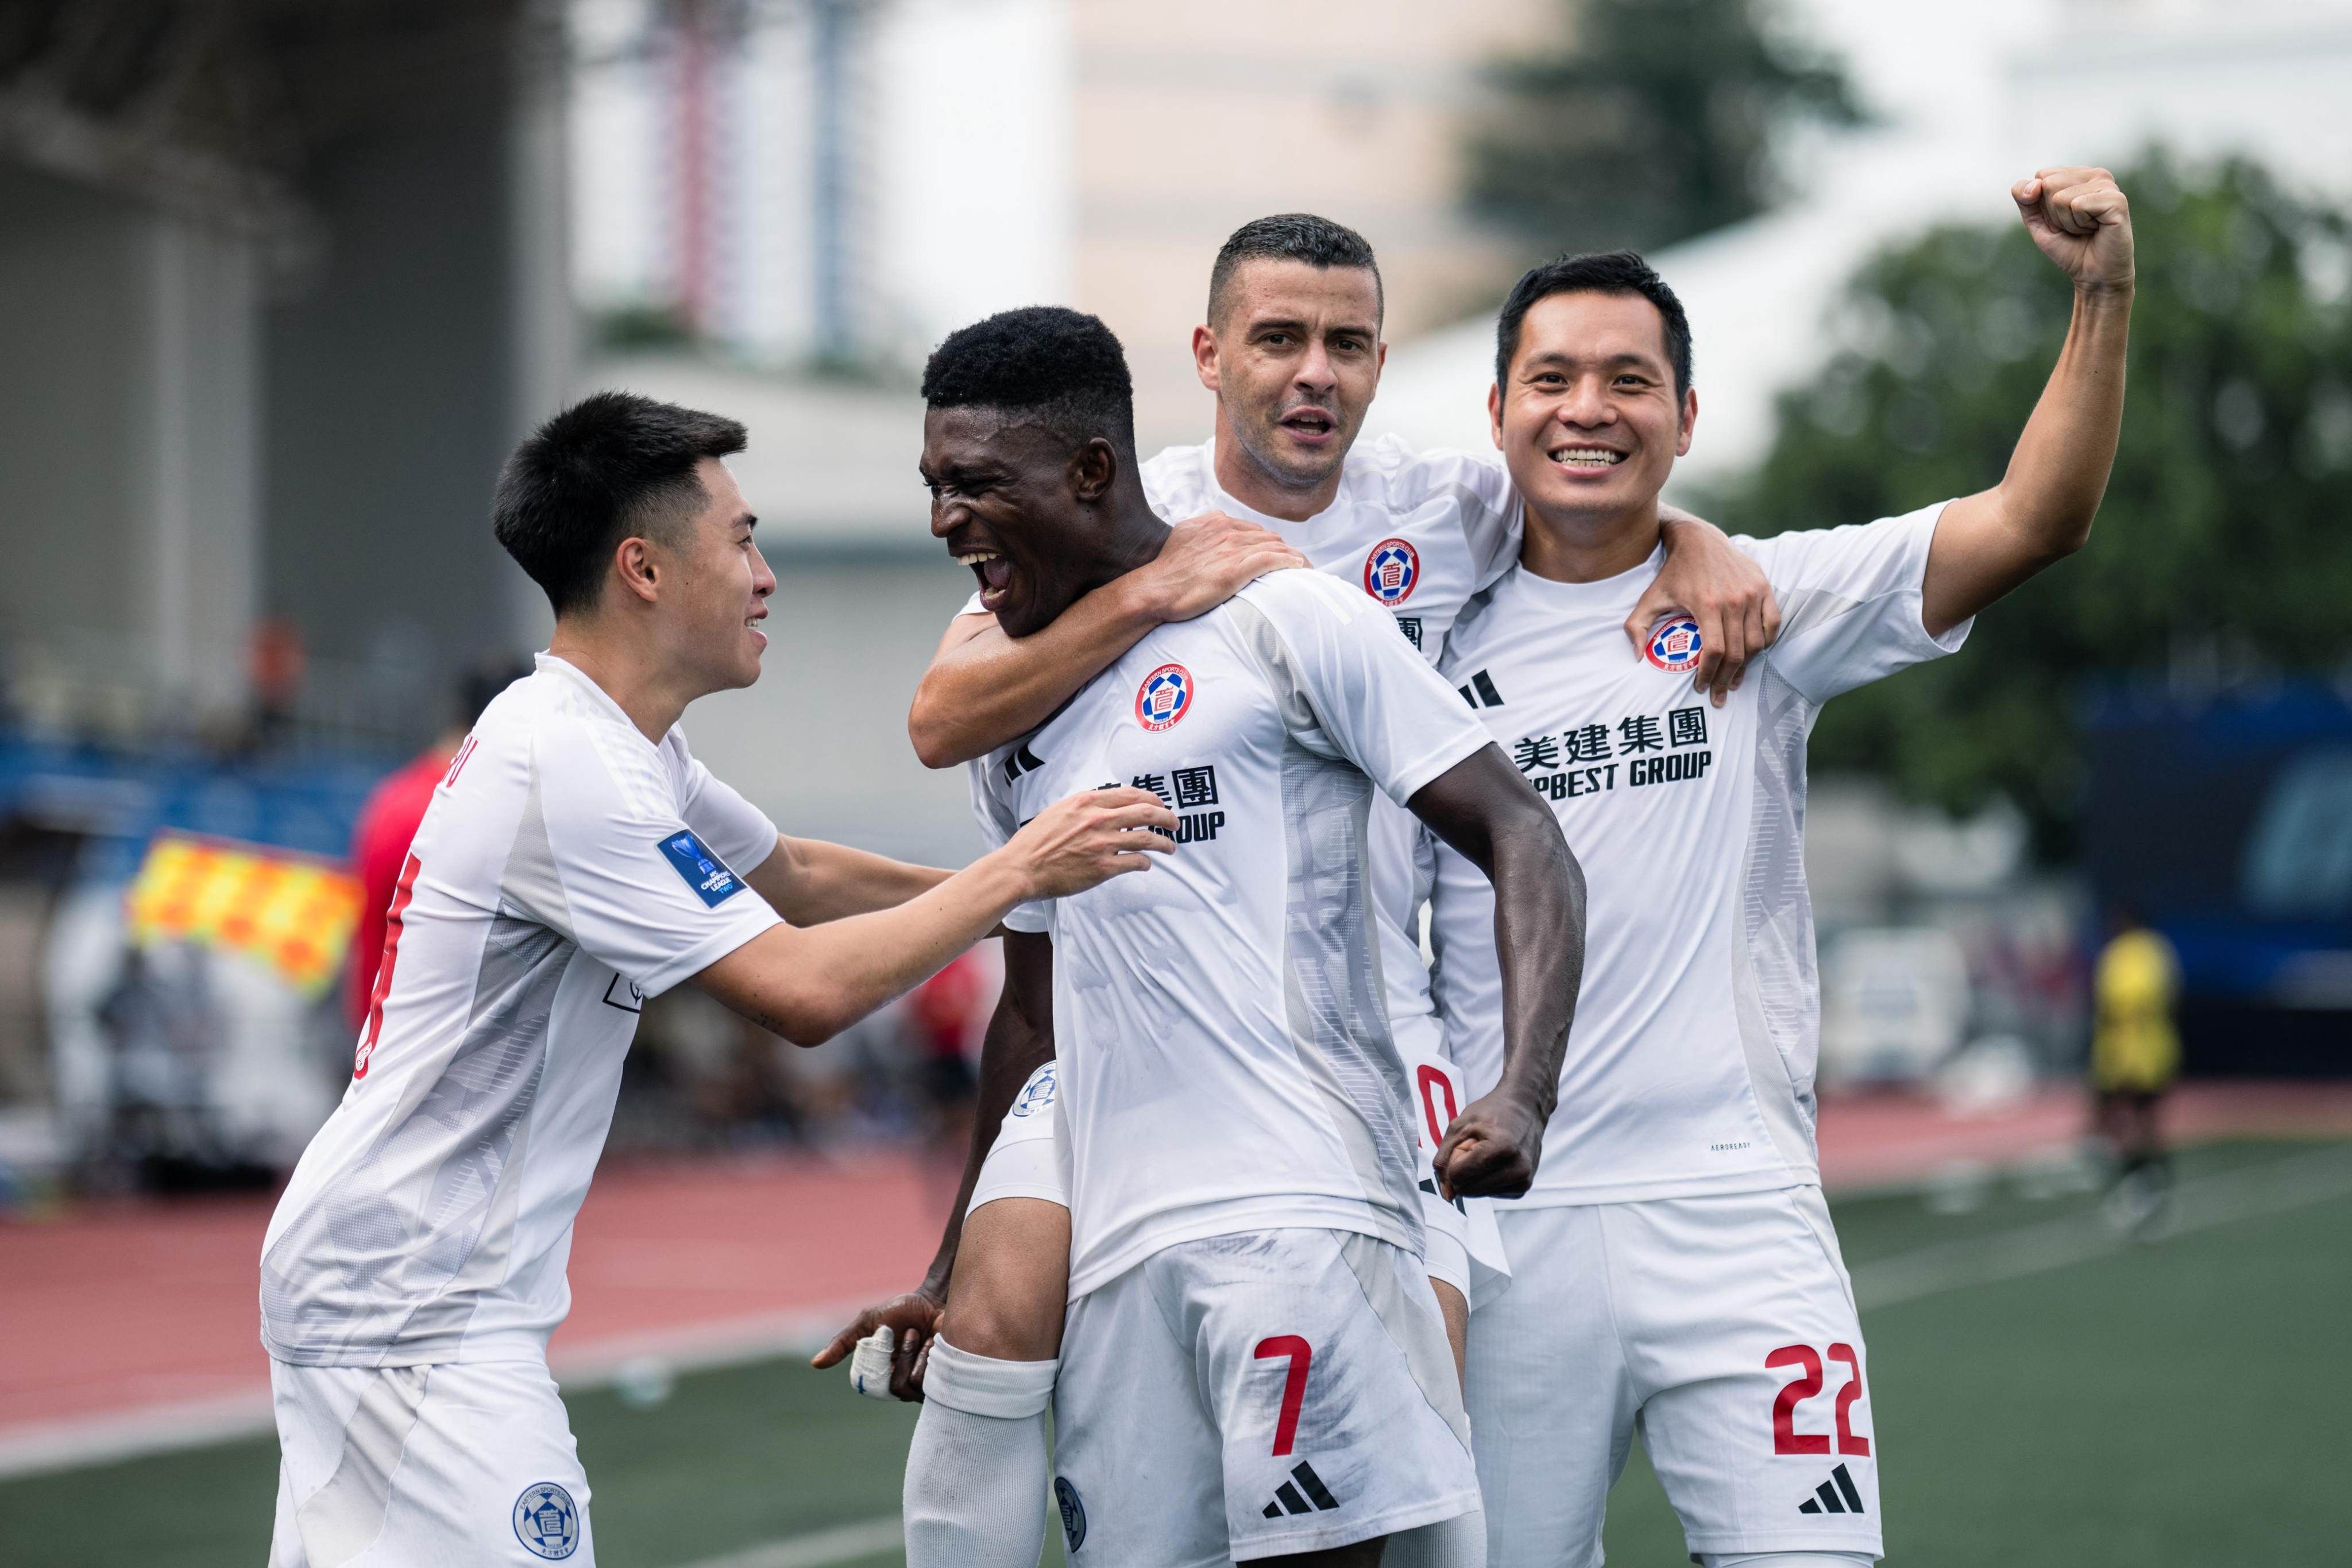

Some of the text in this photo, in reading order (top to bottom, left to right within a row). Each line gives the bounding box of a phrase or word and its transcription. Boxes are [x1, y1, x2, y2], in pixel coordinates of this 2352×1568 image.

[1369, 541, 1415, 565] EASTERN SPORTS CLUB
[1142, 670, 1161, 692] EASTERN
[1179, 669, 1188, 681] CLUB
[1513, 706, 1708, 773] 美建集團
[1528, 751, 1712, 801] PBEST GROUP
[718, 883, 733, 894] TWO
[1710, 1142, 1751, 1152] AEROREADY
[1253, 1334, 1312, 1457] 7
[1764, 1342, 1871, 1458] 22
[520, 1489, 540, 1510] EASTERN
[540, 1486, 561, 1496] SPORTS
